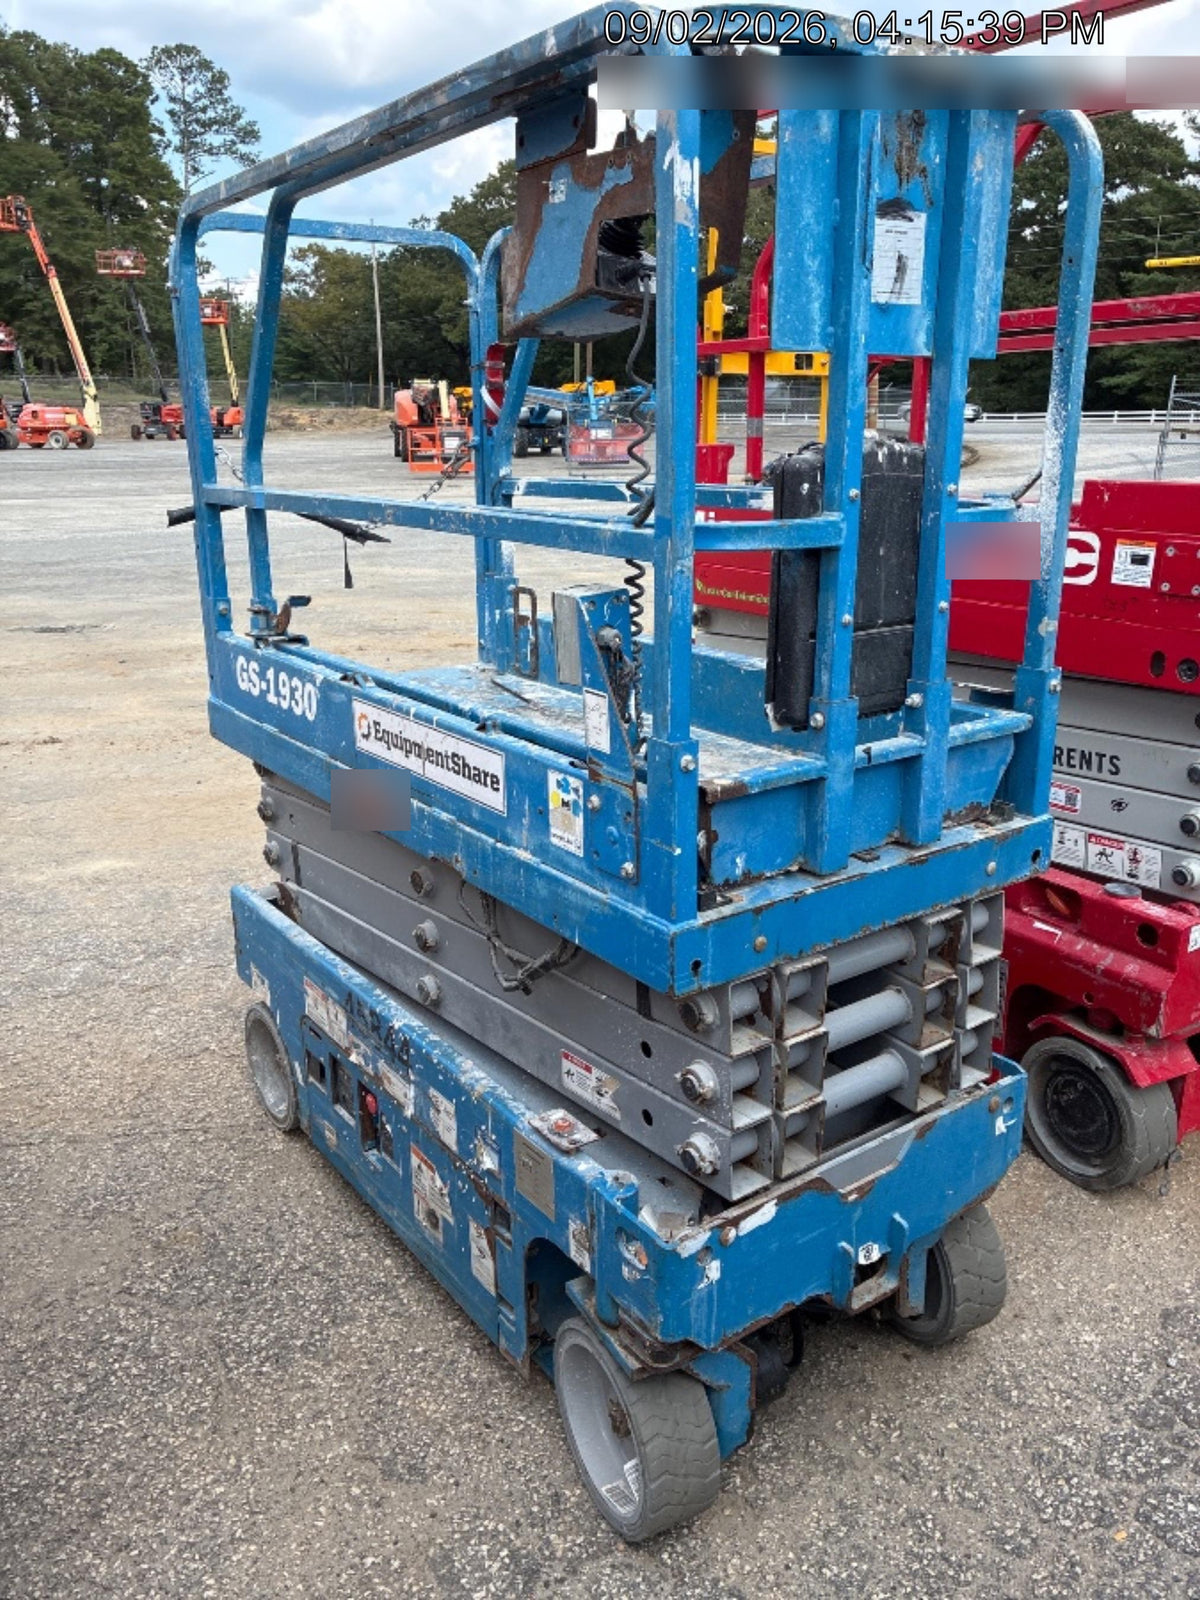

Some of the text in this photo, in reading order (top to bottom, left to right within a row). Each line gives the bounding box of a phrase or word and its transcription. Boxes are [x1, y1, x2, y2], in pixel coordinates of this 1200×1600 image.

[236, 655, 317, 721] GS-1930
[373, 720, 500, 792] EquipmentShare
[1053, 746, 1120, 776] RENTS
